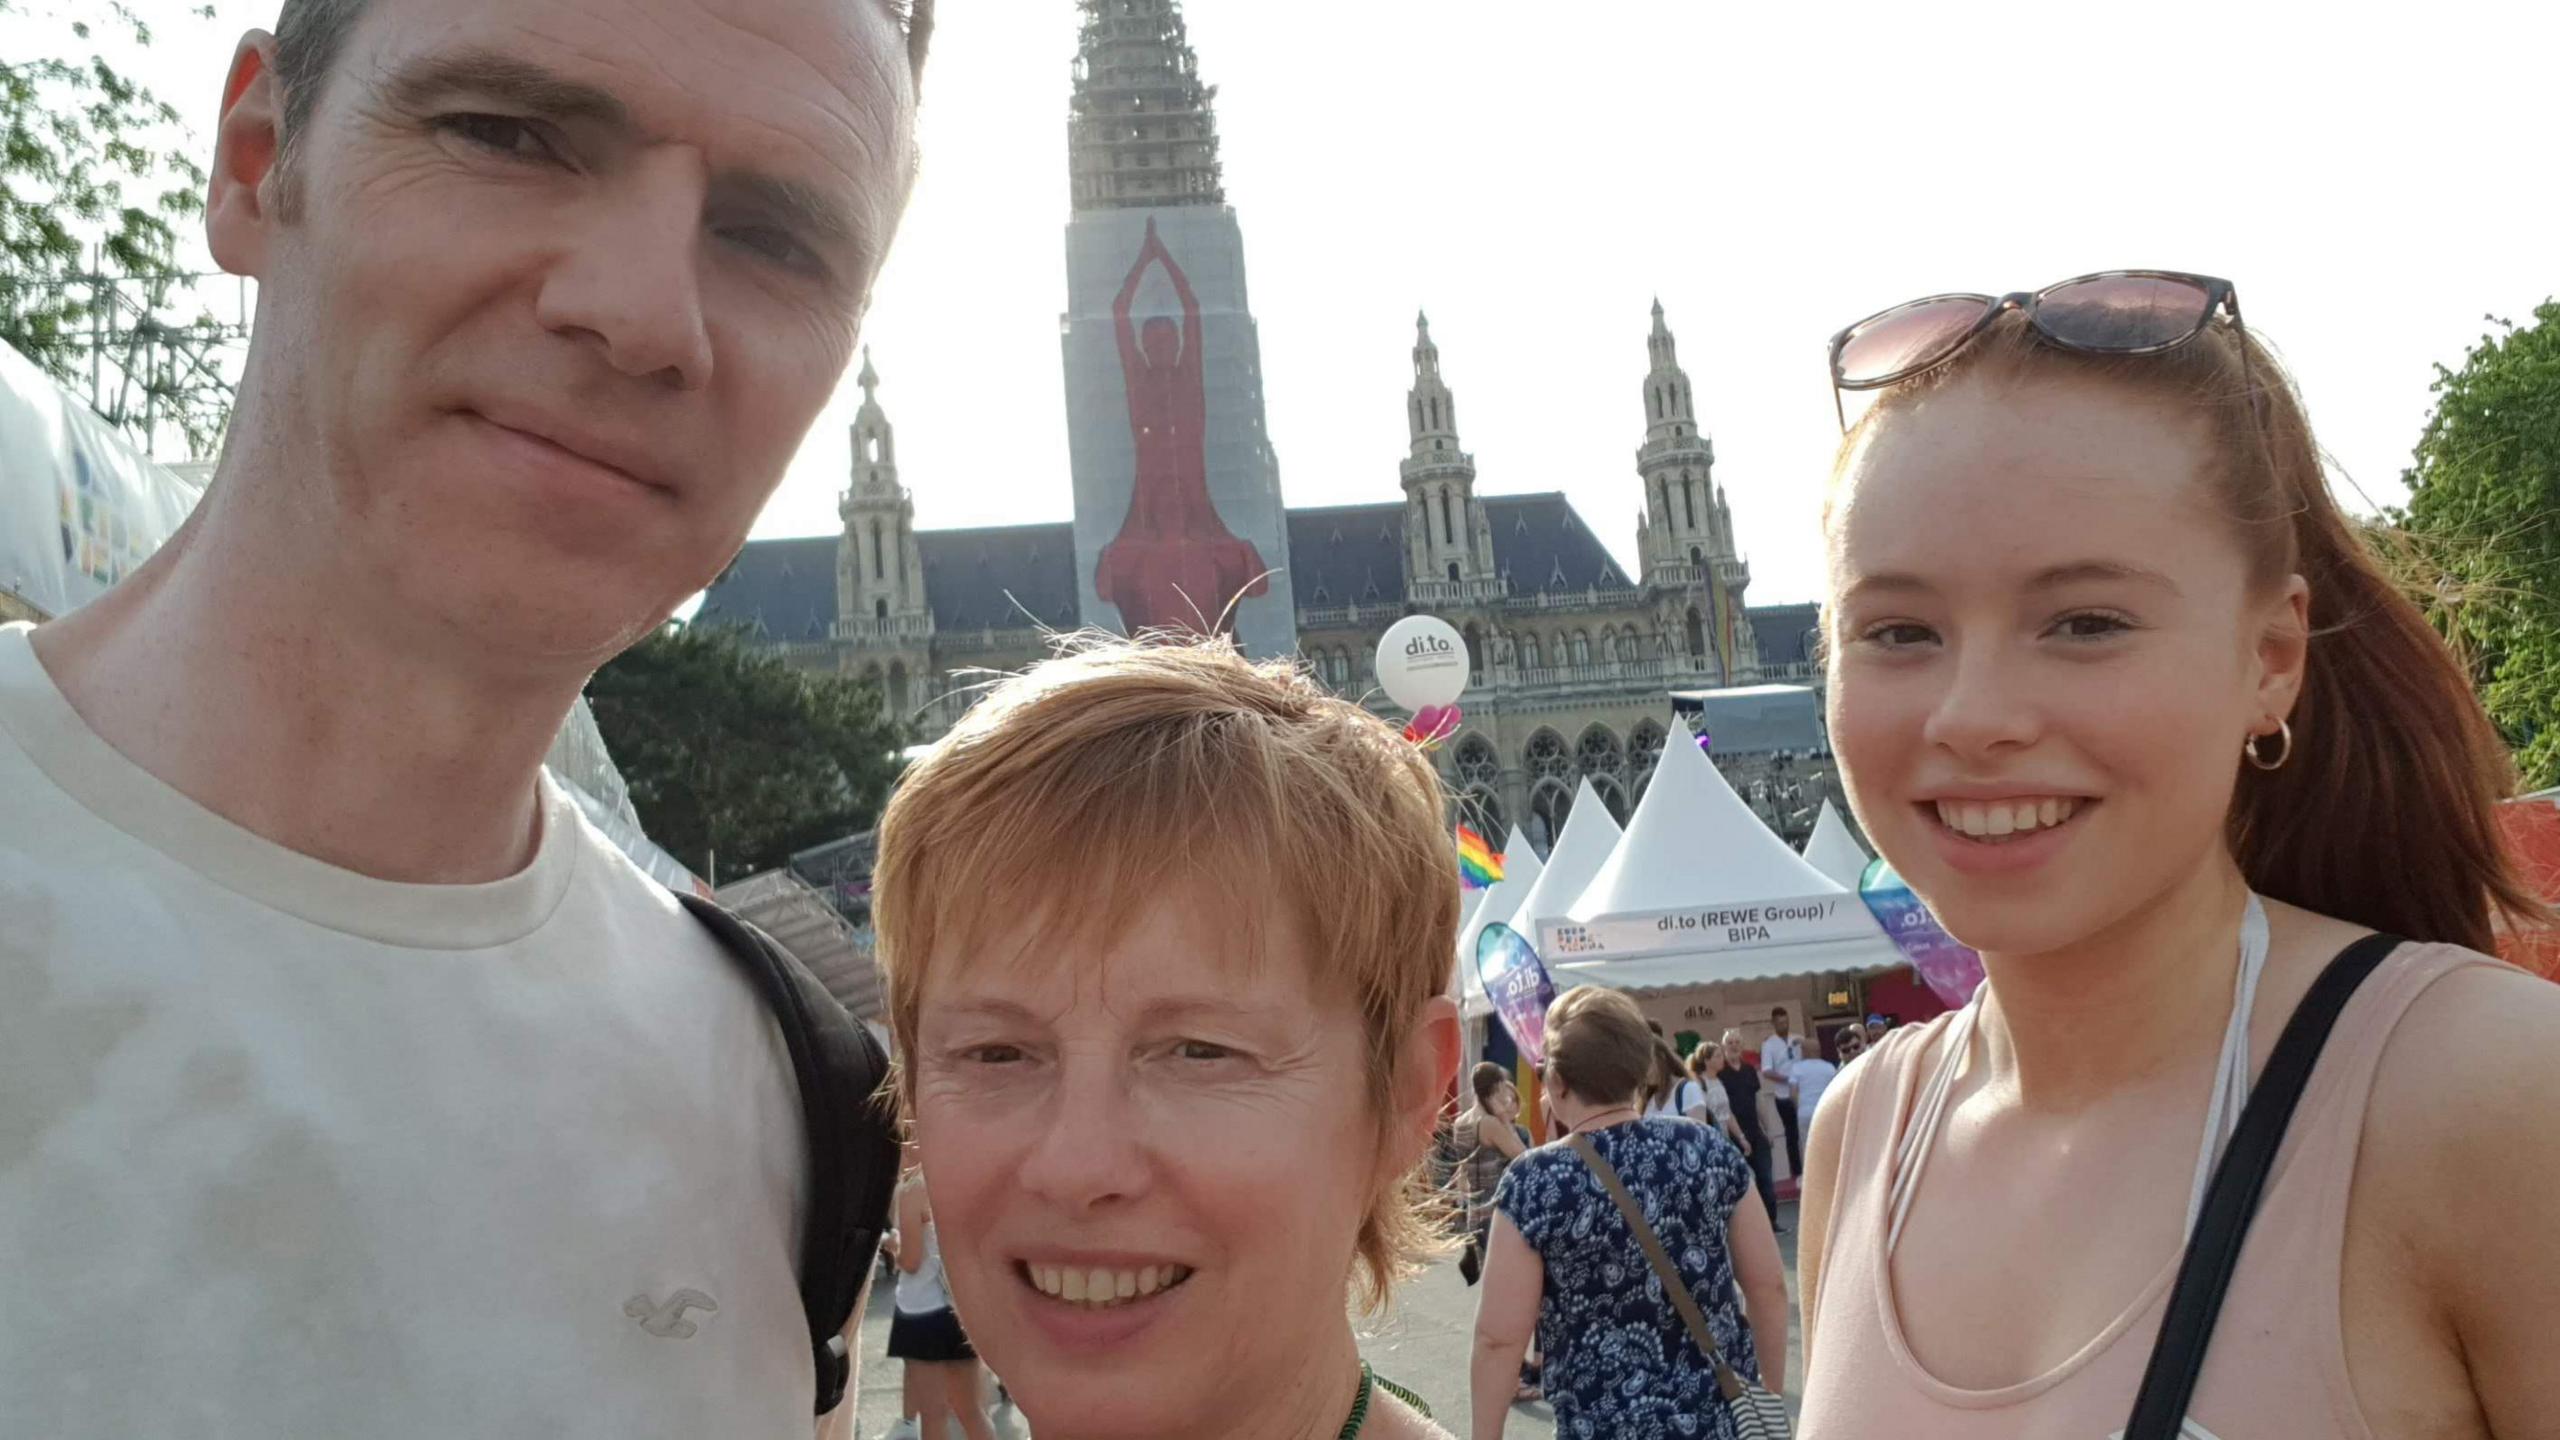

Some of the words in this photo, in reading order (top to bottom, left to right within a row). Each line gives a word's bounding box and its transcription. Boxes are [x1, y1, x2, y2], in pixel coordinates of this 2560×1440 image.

[1405, 634, 1454, 655] di.to.
[1657, 915, 1696, 931] di.to
[1701, 910, 1759, 930] (REWE
[1764, 902, 1824, 921] Group)
[1828, 900, 1836, 917] /
[1728, 926, 1771, 943] BIPA
